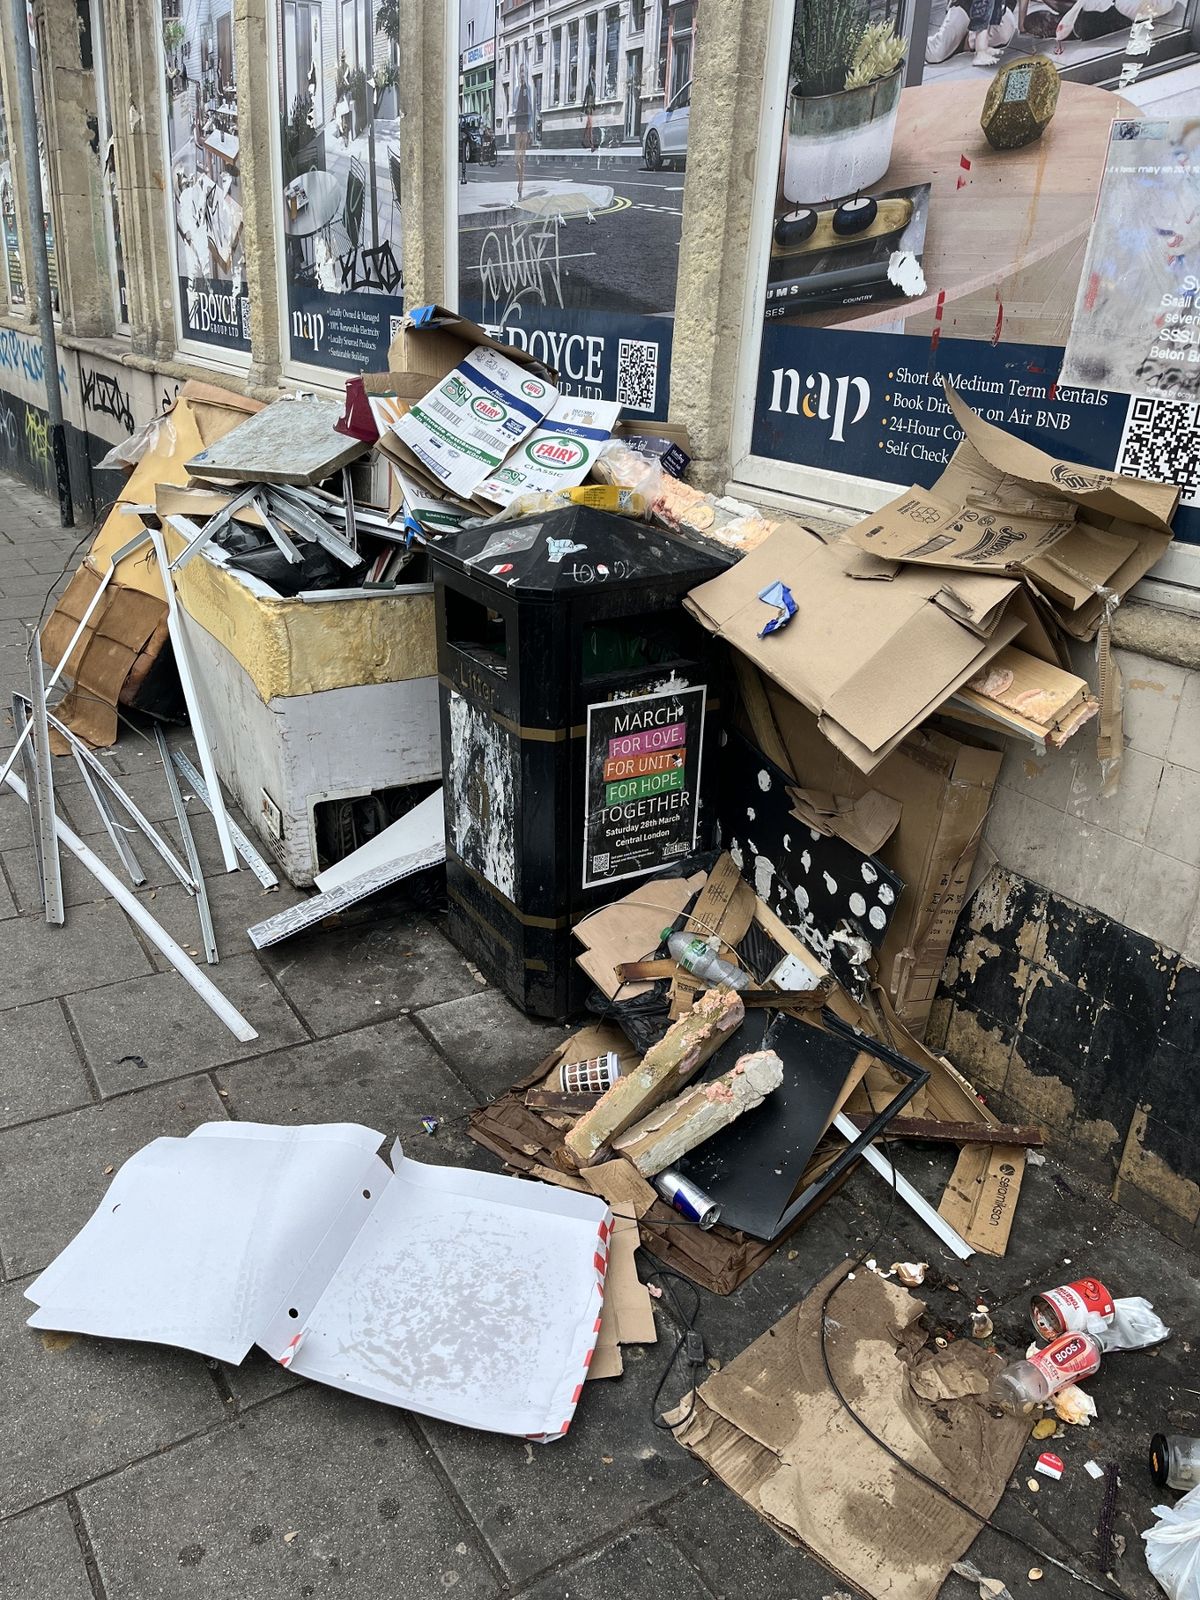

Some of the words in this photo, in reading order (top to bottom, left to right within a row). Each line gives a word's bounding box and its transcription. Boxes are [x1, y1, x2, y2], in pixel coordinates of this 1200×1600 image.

[842, 294, 873, 304] COUNTRY
[198, 292, 238, 331] BOYCE
[328, 307, 342, 319] Locally
[342, 308, 357, 319] Owned
[360, 312, 380, 324] Managed
[764, 307, 785, 318] SES
[210, 323, 227, 335] GROUP
[228, 326, 239, 338] LTD
[292, 311, 324, 351] nap
[339, 323, 361, 334] Renewable
[361, 324, 380, 339] Electricity
[329, 335, 343, 347] Locally
[343, 336, 358, 347] Sourced
[358, 339, 377, 350] Products
[1150, 345, 1185, 361] Beton
[330, 347, 351, 359] Sustainable
[350, 350, 369, 365] Buildings
[895, 367, 930, 387] Short
[932, 371, 944, 387] &
[949, 372, 1004, 395] Medium
[1008, 379, 1047, 399] Term
[1052, 384, 1109, 406] Rentals
[476, 401, 501, 418] FAIRY
[768, 367, 871, 442] nap
[893, 392, 925, 411] Book
[926, 396, 954, 415] Dire
[986, 409, 1004, 422] on
[1007, 407, 1033, 426] Air
[1035, 410, 1071, 430] BNB
[888, 416, 941, 438] 24-Hour
[535, 443, 578, 462] FAIRY
[885, 439, 909, 457] Self
[911, 444, 949, 465] Check
[524, 463, 564, 478] CLASSIC
[460, 661, 495, 705] Litter
[614, 707, 679, 733] MARCH
[613, 738, 641, 757] FOR
[645, 727, 683, 748] LOVE.
[607, 759, 634, 776] FOR
[609, 782, 637, 801] FOR
[641, 771, 681, 793] HOPE.
[601, 791, 690, 824] TOGETHER
[605, 823, 640, 837] Saturday
[640, 819, 657, 830] 28th
[658, 814, 681, 825] March
[615, 836, 643, 847] Central
[643, 829, 670, 841] London
[989, 1176, 1011, 1227] seromikson
